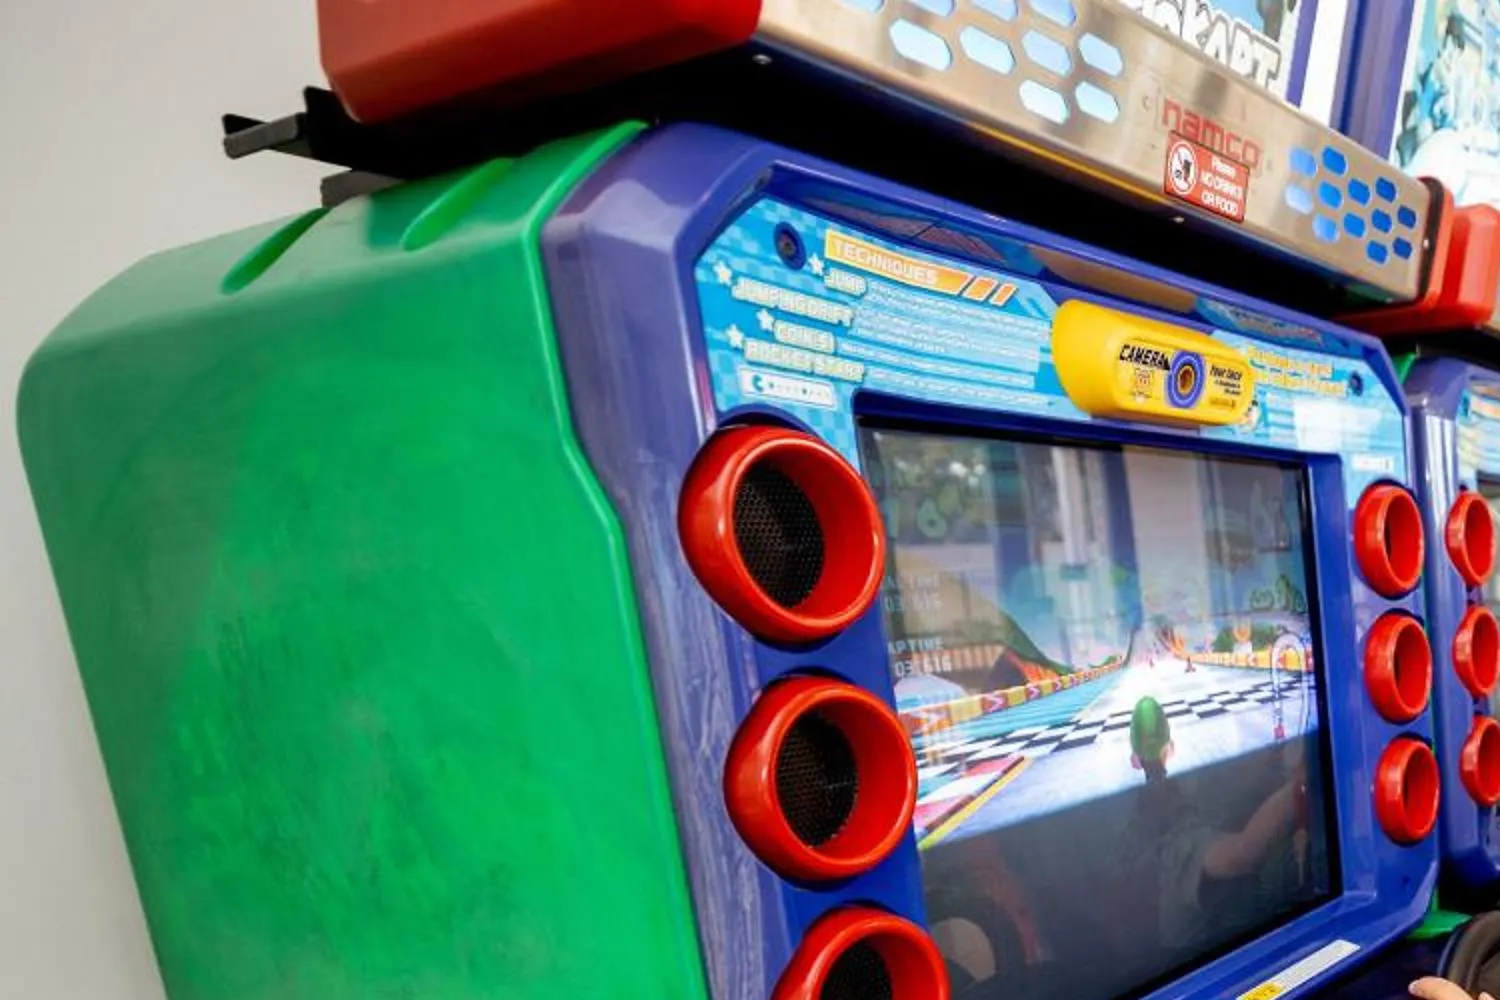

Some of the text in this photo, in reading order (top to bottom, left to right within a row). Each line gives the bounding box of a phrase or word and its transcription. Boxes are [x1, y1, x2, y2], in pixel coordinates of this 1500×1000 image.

[1162, 98, 1262, 170] namco
[832, 238, 939, 286] TECHNIQUES
[1118, 344, 1172, 371] CAMERA
